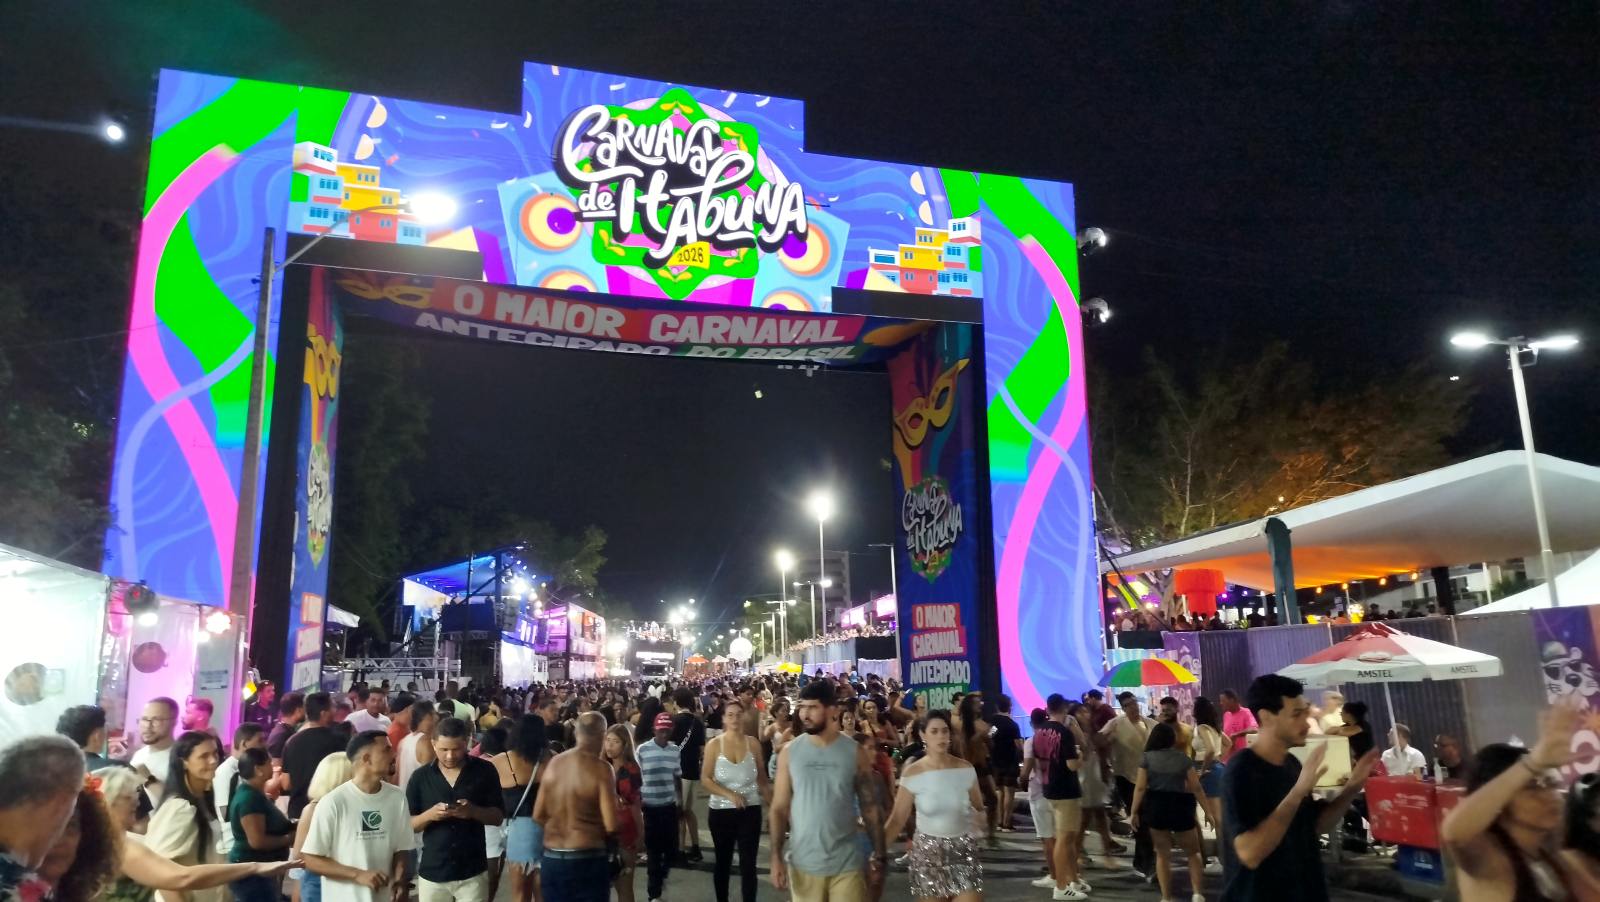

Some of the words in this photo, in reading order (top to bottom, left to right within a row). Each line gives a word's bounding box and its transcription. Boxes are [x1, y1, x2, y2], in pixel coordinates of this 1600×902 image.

[578, 183, 616, 212] de
[678, 247, 704, 264] 2026
[453, 285, 484, 316] O
[495, 291, 625, 339] MAIOR
[650, 314, 844, 344] CARNAVAL
[416, 312, 671, 355] ANTECIPADO
[686, 346, 738, 358] DO
[741, 345, 855, 360] BRASIL
[916, 606, 924, 628] O
[912, 630, 964, 658] CARNAVAL
[910, 660, 971, 685] ANTECIPADO
[1357, 670, 1393, 678] AMSTEL
[1450, 665, 1478, 673] AMSTEL
